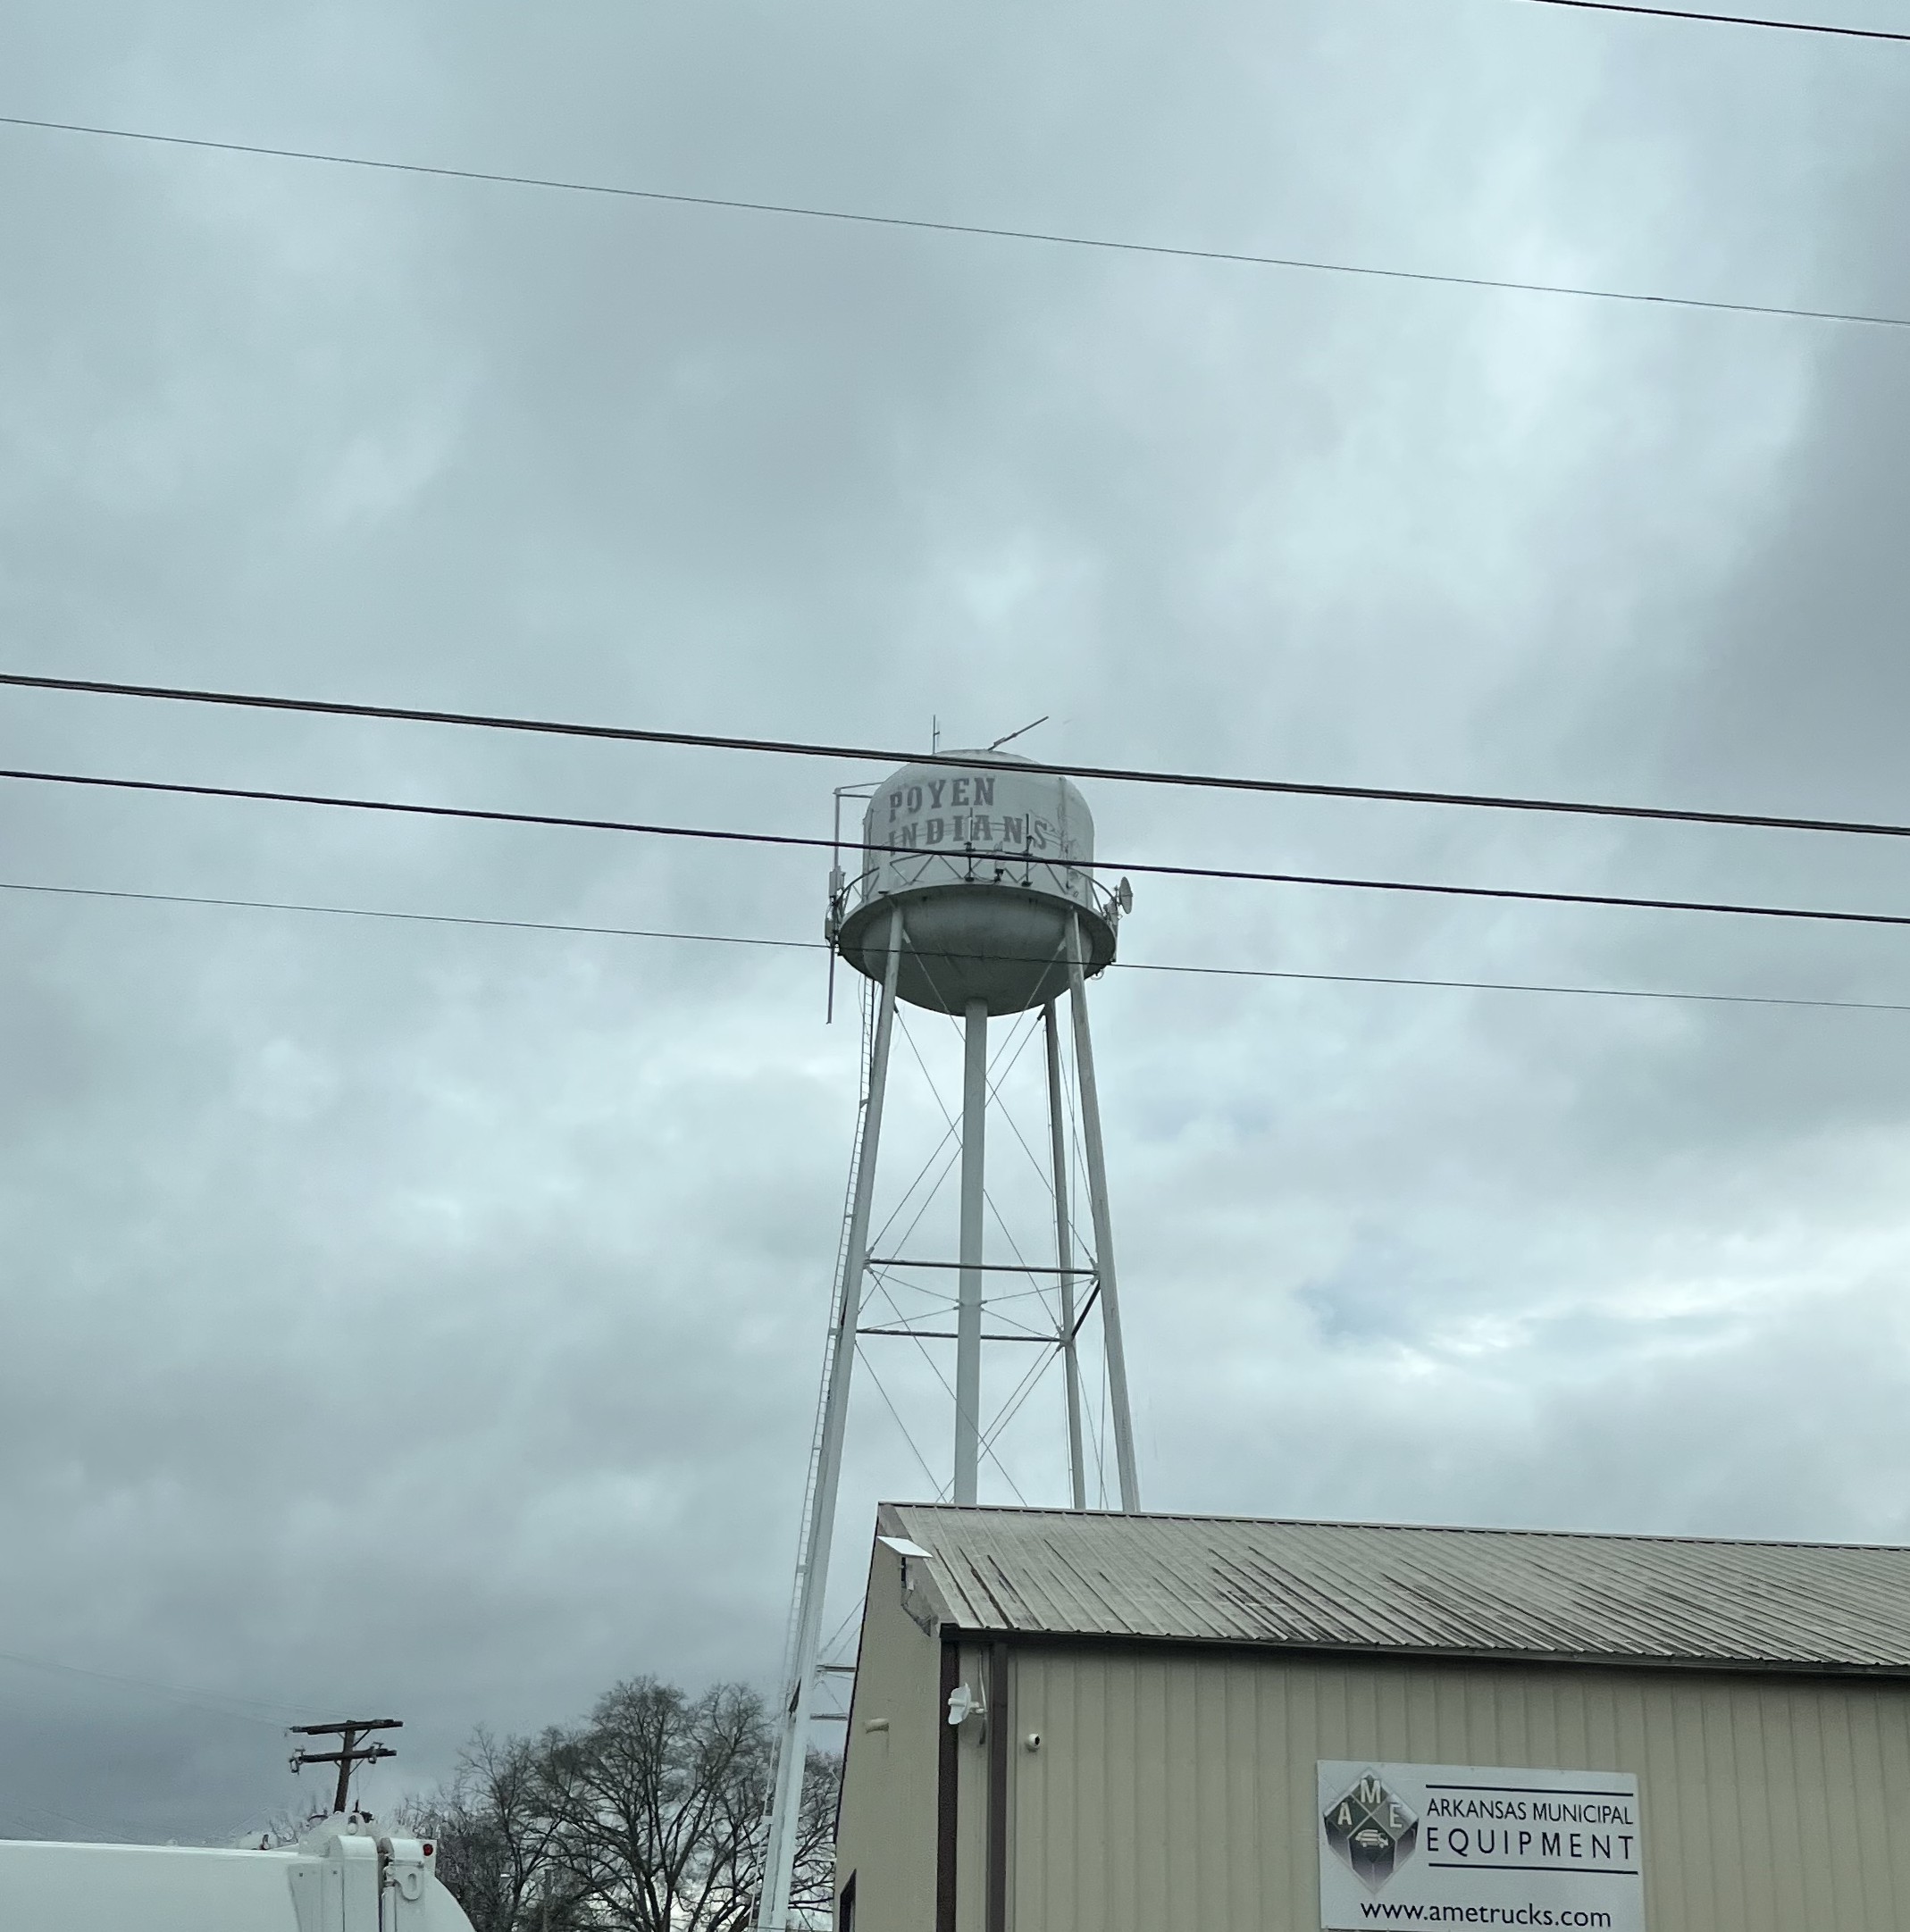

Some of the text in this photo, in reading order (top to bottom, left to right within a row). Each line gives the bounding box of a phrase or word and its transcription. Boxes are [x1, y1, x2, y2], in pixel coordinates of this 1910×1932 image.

[889, 777, 995, 823] POYEN
[889, 815, 1047, 857] INDIANS
[1427, 1798, 1634, 1825] ARKANSAS MUNICIPAL
[1428, 1827, 1634, 1860] EQUIPMENT
[1360, 1903, 1612, 1928] www.ametrucks.com
